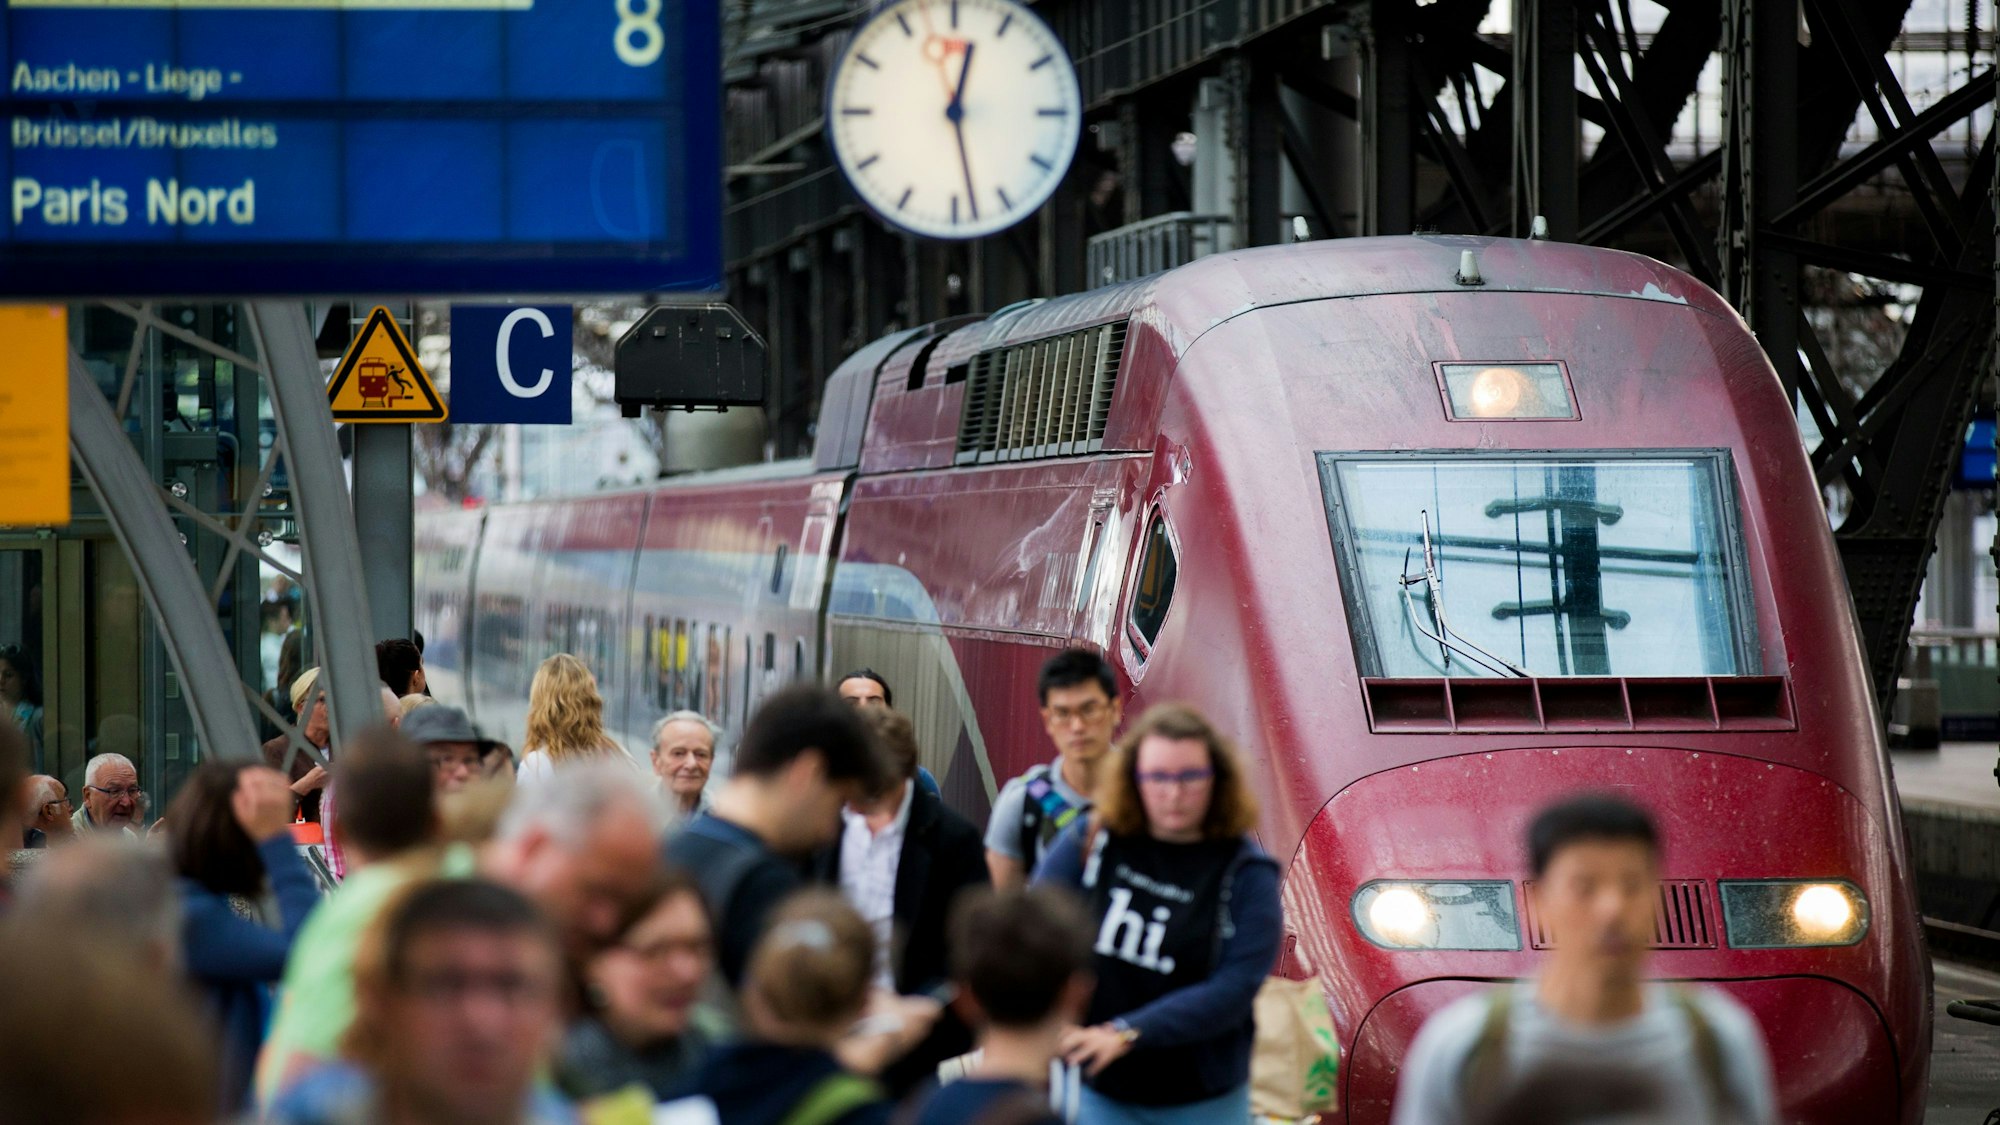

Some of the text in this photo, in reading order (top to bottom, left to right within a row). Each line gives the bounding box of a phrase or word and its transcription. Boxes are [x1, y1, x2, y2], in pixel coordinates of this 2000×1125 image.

[613, 0, 665, 67] 8
[12, 61, 121, 93] Aachen
[146, 63, 222, 100] Liege
[12, 117, 278, 148] Brüssel/Bruxelles
[12, 177, 255, 225] Paris Nord
[495, 307, 555, 398] C
[1094, 887, 1176, 975] hi.
